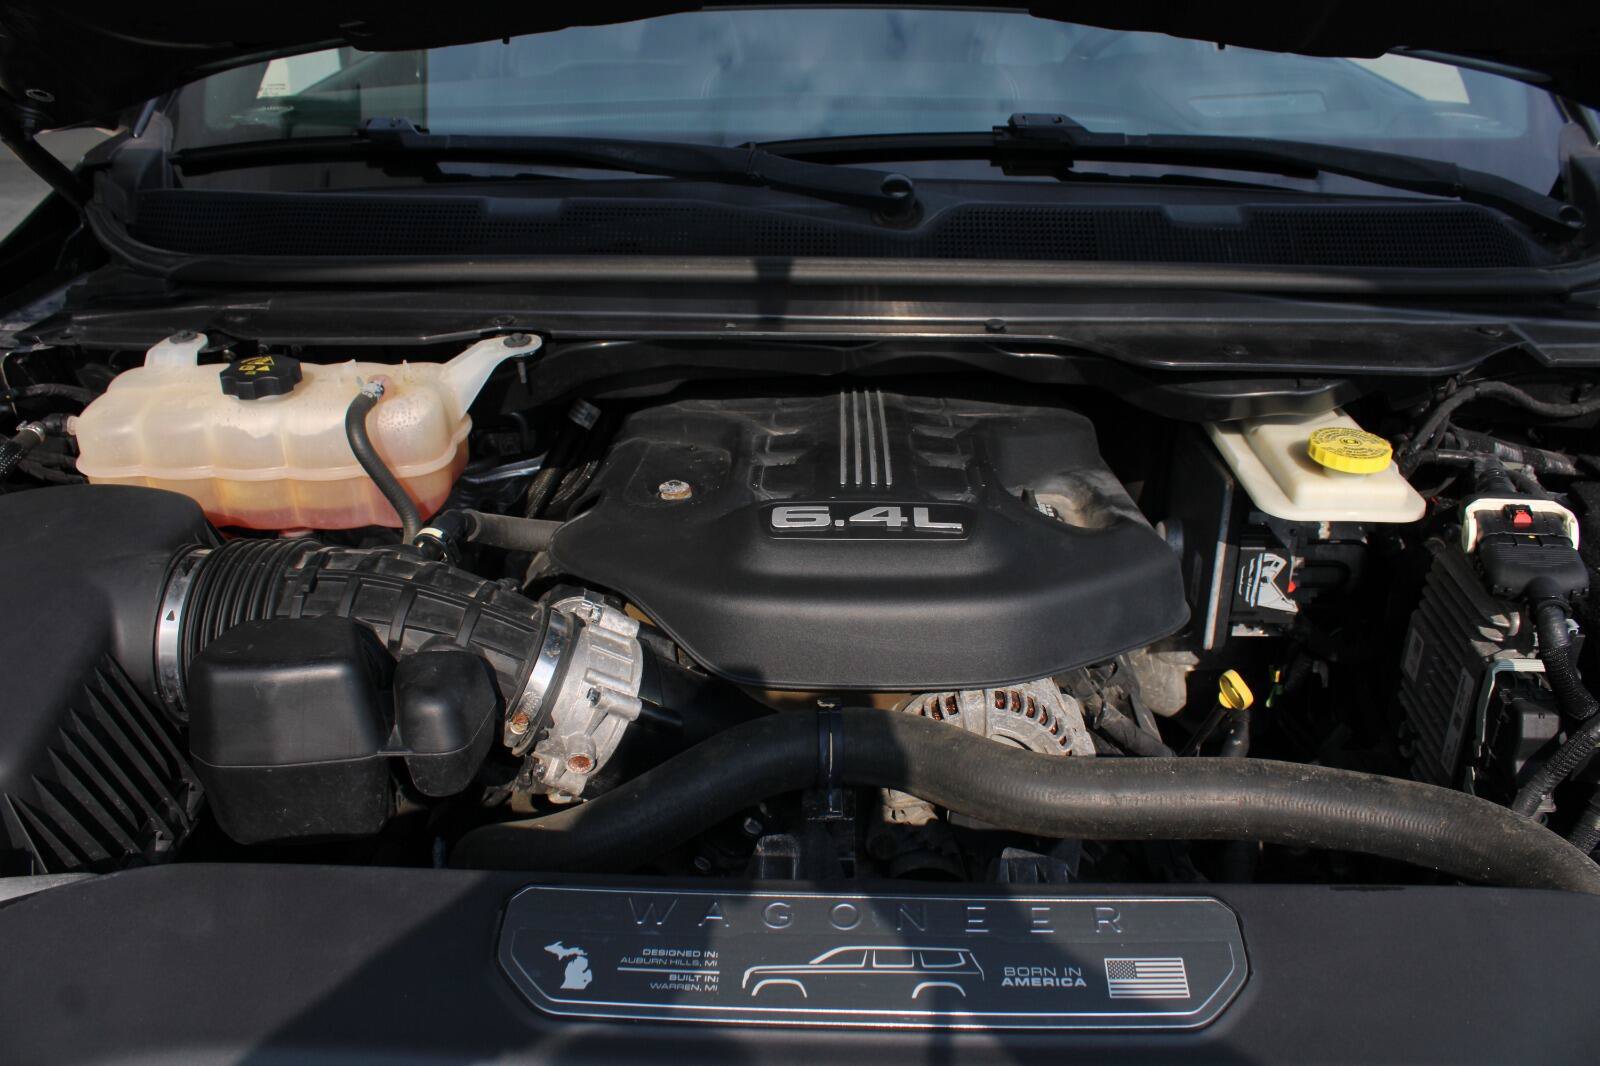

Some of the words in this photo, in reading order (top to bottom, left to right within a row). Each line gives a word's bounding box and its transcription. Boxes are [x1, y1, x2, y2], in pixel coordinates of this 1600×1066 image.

[771, 506, 963, 533] 6.4L
[627, 896, 1124, 934] WAGONEER
[642, 948, 701, 957] DESIGNED
[703, 951, 719, 959] IN:
[620, 956, 667, 965] AUBURN
[669, 959, 702, 967] HILLS,
[1004, 966, 1057, 976] BORN
[1064, 967, 1082, 977] IN
[669, 974, 702, 982] BUILT
[704, 975, 719, 983] IN:
[1002, 977, 1087, 987] AMERICA
[649, 983, 702, 992] WARREN,
[704, 984, 718, 992] MI
